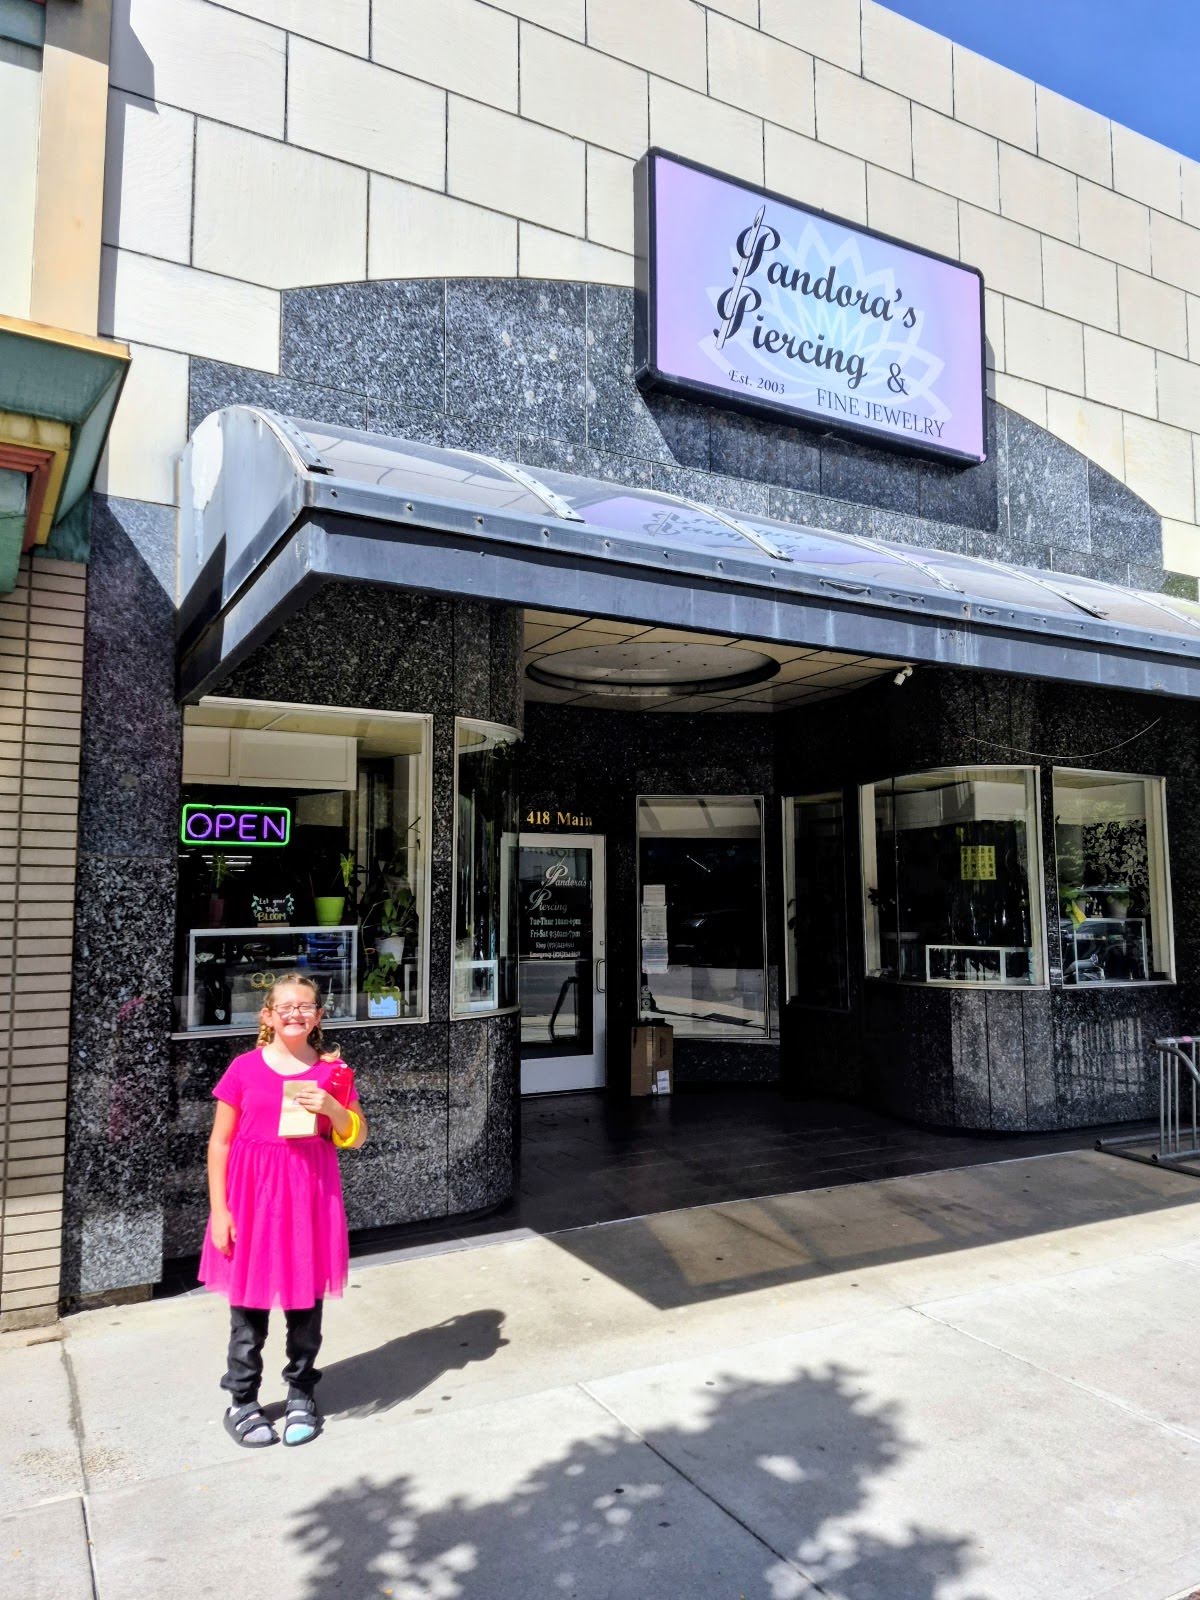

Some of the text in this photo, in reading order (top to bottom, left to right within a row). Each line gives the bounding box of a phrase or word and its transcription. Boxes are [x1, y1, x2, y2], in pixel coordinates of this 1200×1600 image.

[732, 224, 917, 328] Pandora's
[713, 284, 910, 396] Piercing &
[728, 368, 786, 396] Est. 2003
[815, 387, 946, 438] FINE JEWELRY
[186, 813, 286, 840] OPEN
[526, 811, 593, 826] 418 Main
[540, 862, 587, 888] Pandora's
[525, 889, 568, 913] Piercing
[257, 912, 287, 921] BLOOM
